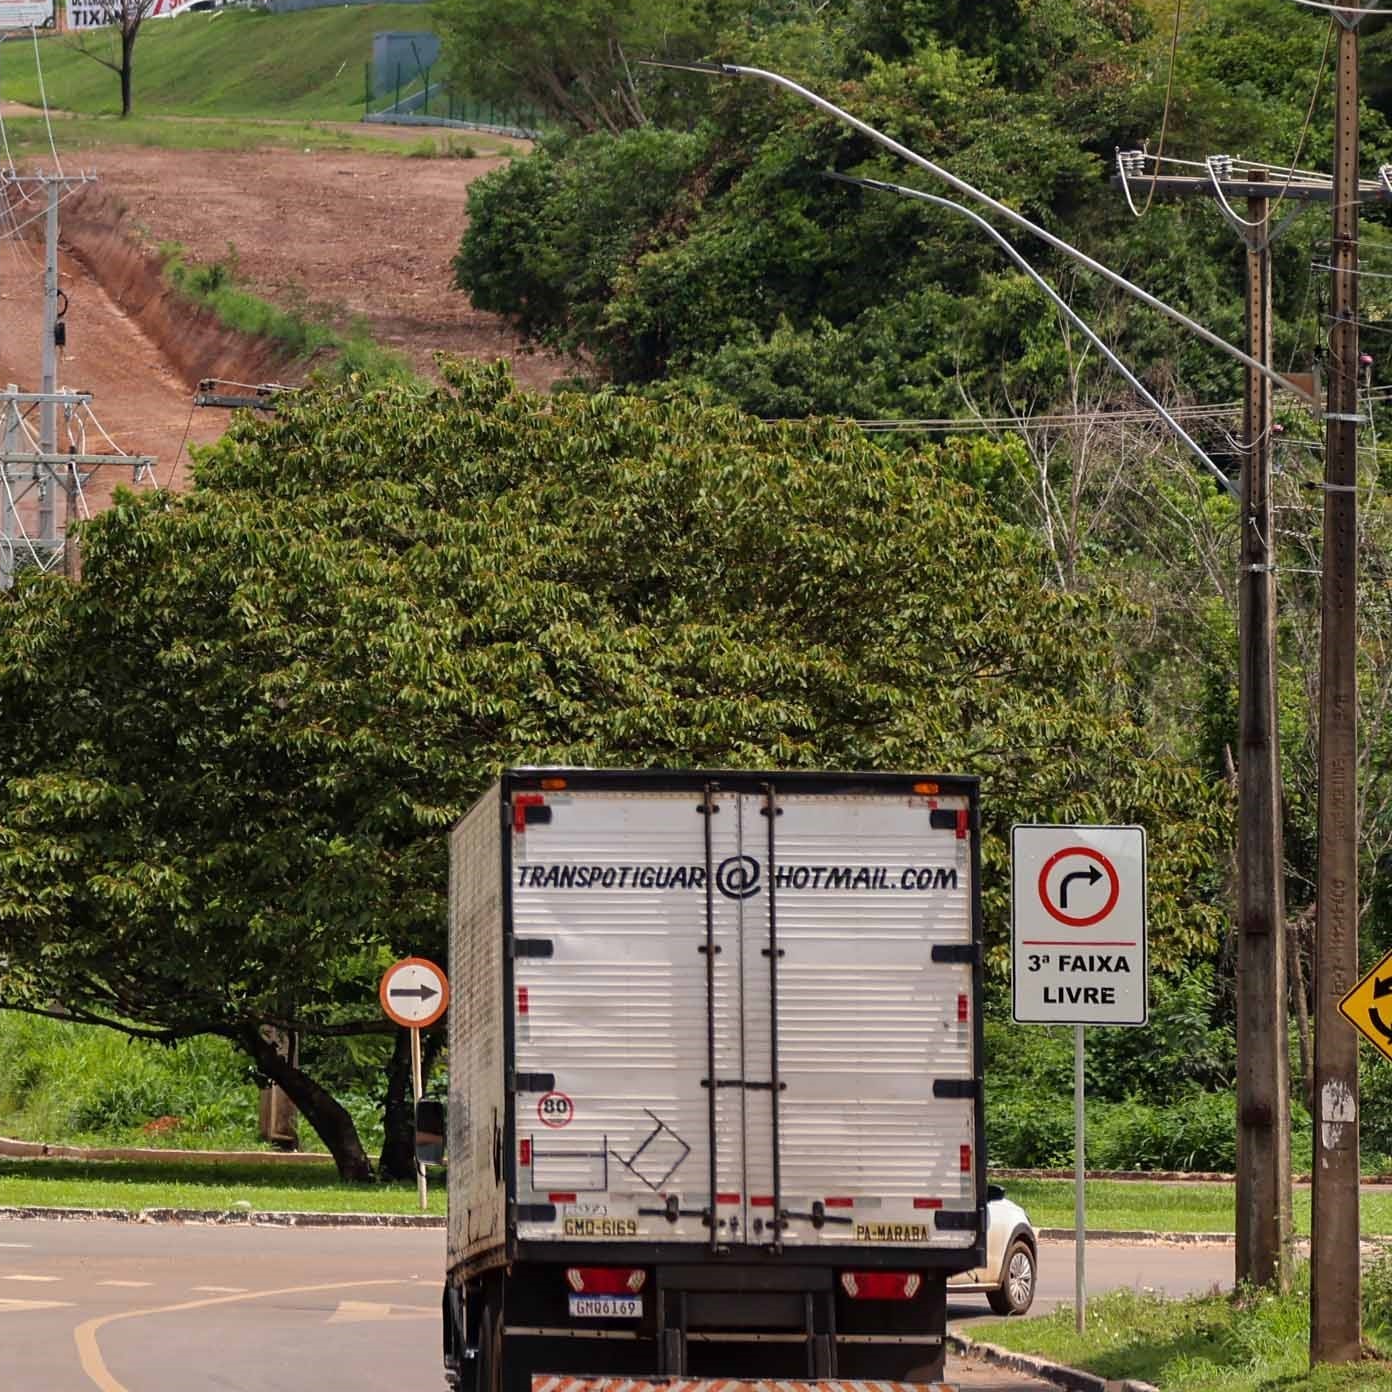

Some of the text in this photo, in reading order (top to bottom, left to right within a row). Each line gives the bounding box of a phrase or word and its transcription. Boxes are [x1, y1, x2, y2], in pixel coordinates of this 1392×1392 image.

[1058, 954, 1131, 973] FAIXA
[1042, 986, 1116, 1005] LIVRE
[543, 1098, 568, 1114] 80
